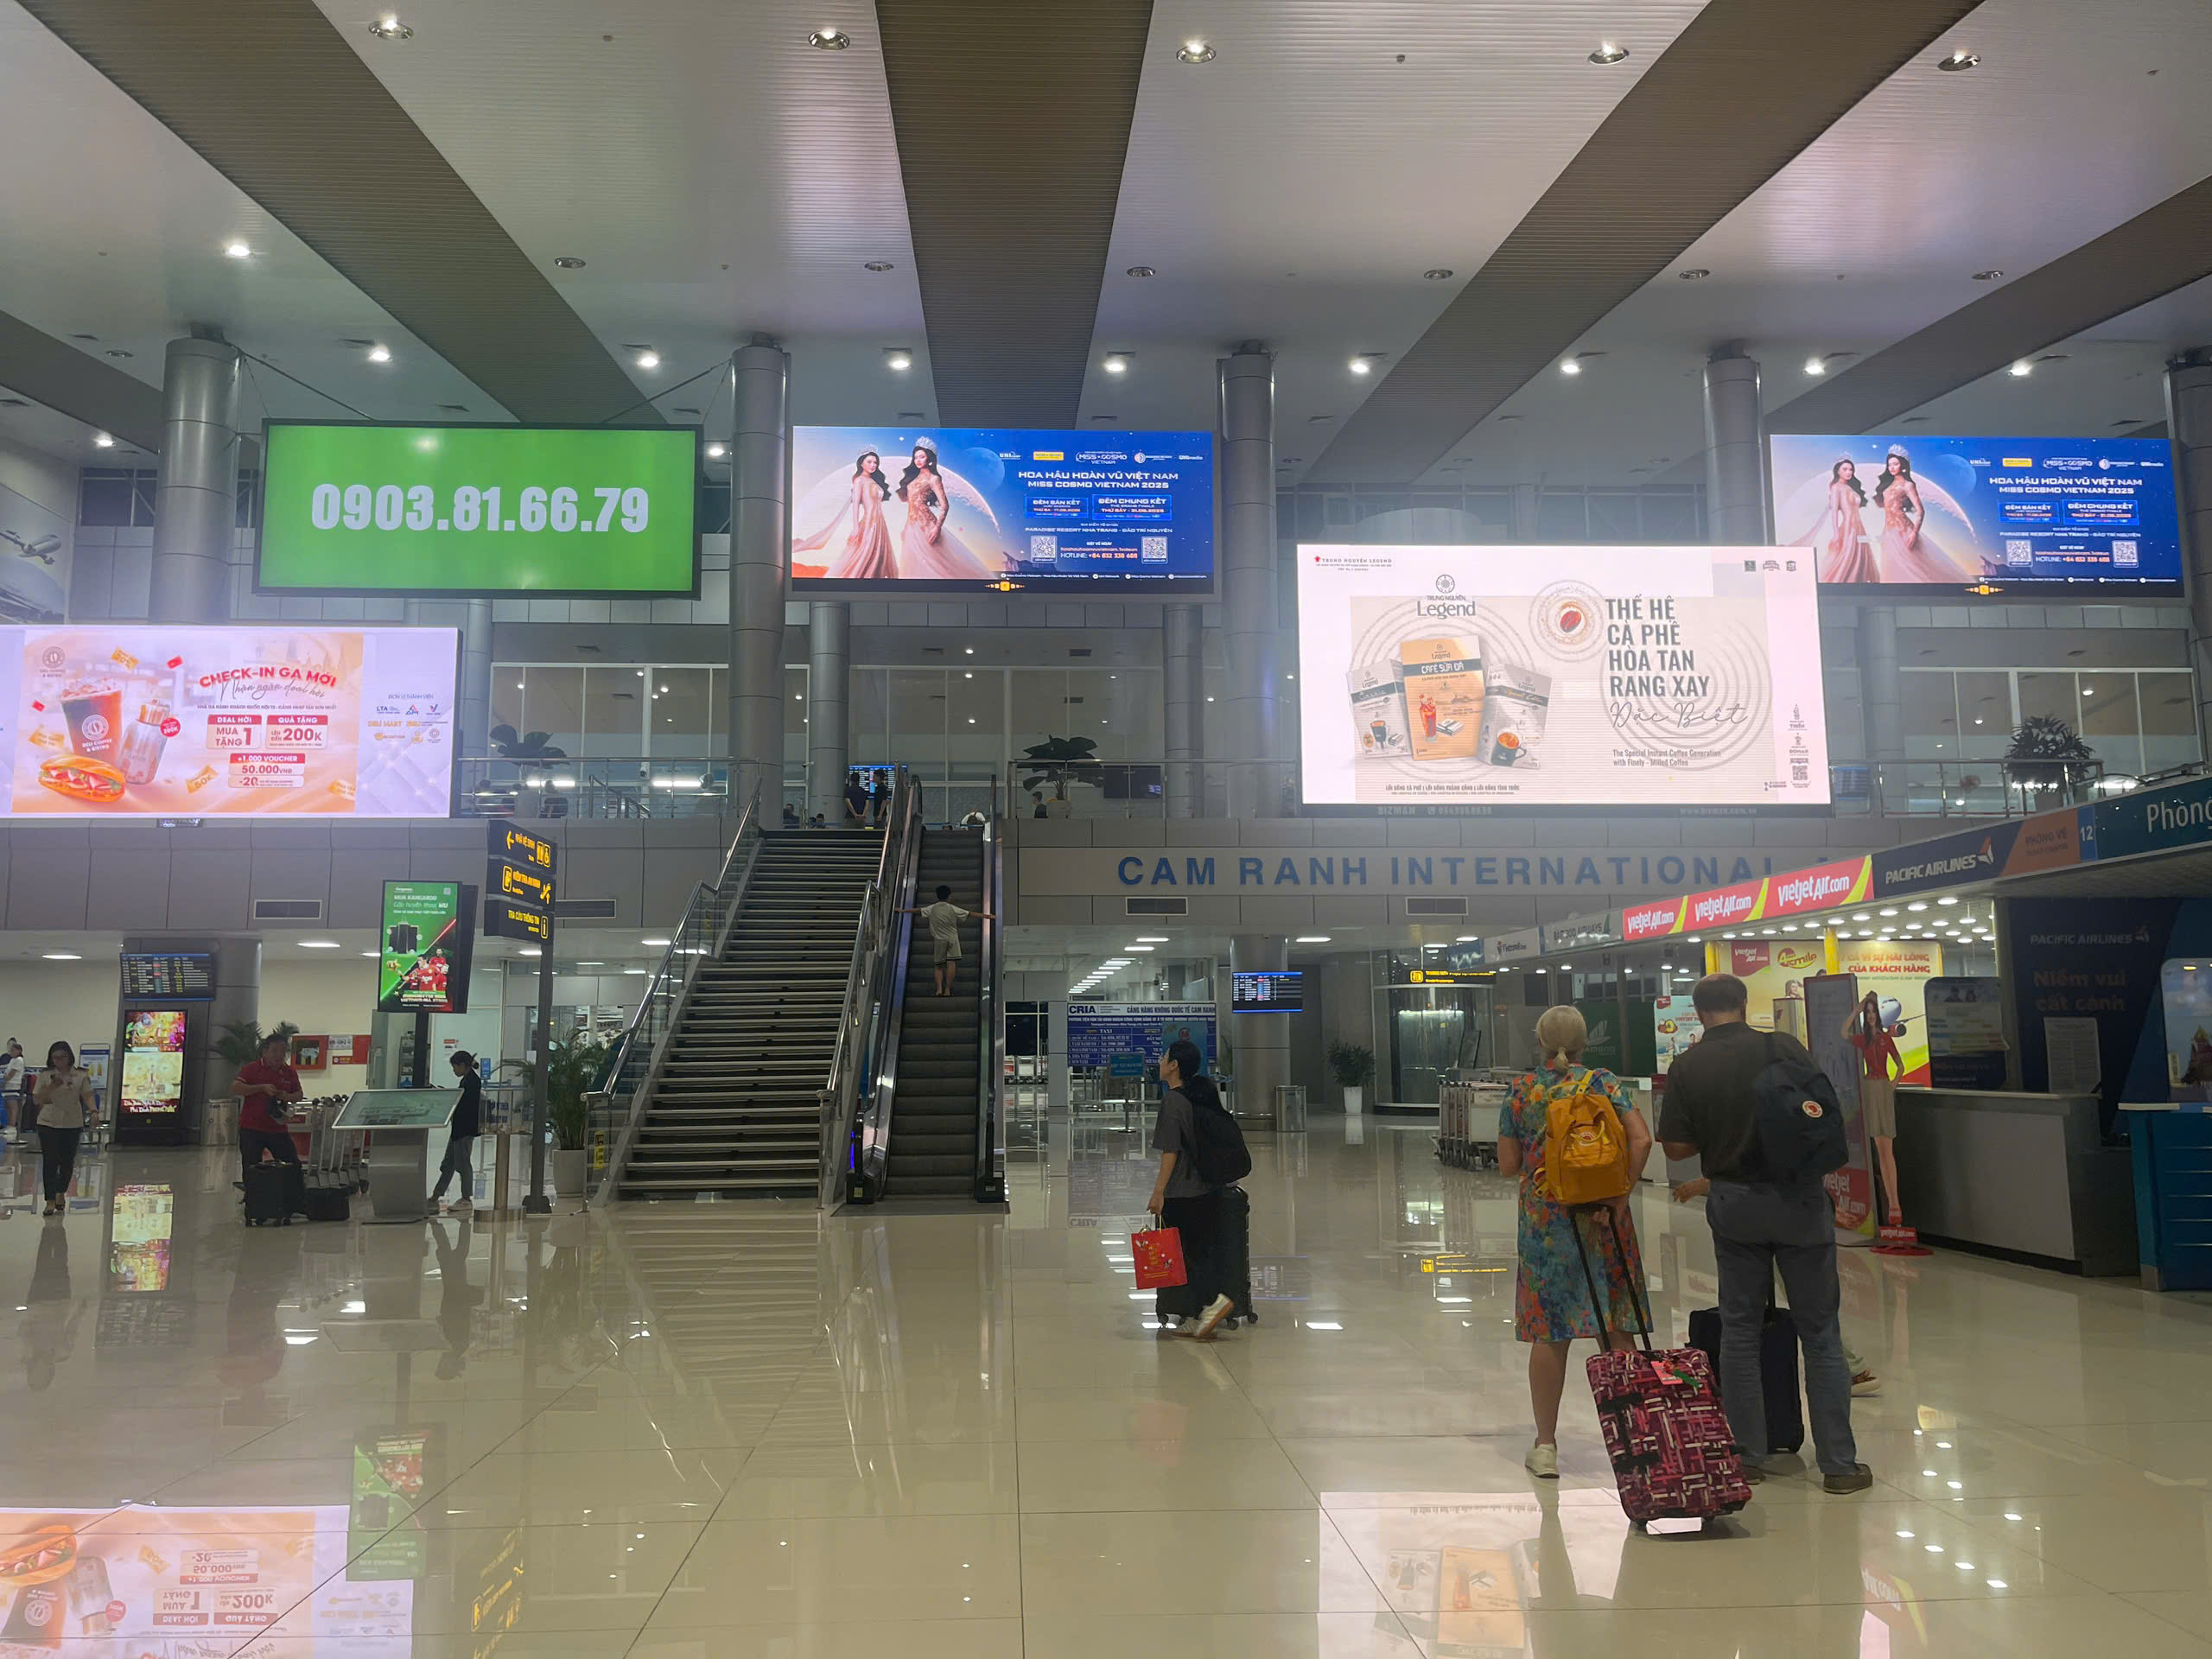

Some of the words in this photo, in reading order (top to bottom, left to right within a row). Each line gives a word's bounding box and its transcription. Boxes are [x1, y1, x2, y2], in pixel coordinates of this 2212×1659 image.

[1046, 470, 1070, 480] HẬU
[1072, 470, 1104, 480] HOÀN
[1107, 471, 1123, 480] VŨ
[1125, 471, 1150, 481] VIỆT
[2016, 477, 2039, 486] HẬU
[2041, 477, 2073, 486] HOÀN
[2093, 477, 2115, 486] VIỆT
[311, 484, 649, 532] 0903.81.66.79
[1417, 601, 1476, 620] Legend
[1605, 594, 1643, 620] THẾ
[1649, 595, 1675, 622] HỆ
[1607, 620, 1635, 646] CÀ
[1642, 620, 1681, 645] PHÊ
[1431, 652, 1451, 660] Legend
[1609, 645, 1651, 671] HÒA
[1657, 650, 1695, 671] TAN
[200, 667, 275, 688] CHECK-IN
[279, 667, 302, 679] GA
[306, 671, 337, 688] MỚI
[1611, 676, 1666, 696] RANG
[1673, 676, 1710, 696] XAY
[1611, 702, 1668, 728] Đặc
[1675, 702, 1747, 728] Biệt
[244, 728, 252, 746] 1
[283, 728, 322, 741] 200K
[216, 738, 243, 748] TẶNG
[1624, 749, 1645, 759] Special
[1628, 759, 1644, 767] Finely
[2025, 833, 2055, 845] PHÒNG
[2081, 825, 2094, 842] 12
[1118, 857, 1215, 886] CAM
[1239, 857, 1369, 886] RANH
[1885, 865, 1923, 884] PACIFIC
[1925, 855, 1977, 878] AIRLINES
[2031, 935, 2075, 945] PACIFIC
[2077, 934, 2133, 944] AIRLINES
[1885, 952, 1901, 963] HÀI
[1904, 952, 1929, 963] LÒNG
[1847, 963, 1866, 973] CỦA
[1869, 963, 1901, 973] KHÁCH
[1903, 963, 1930, 973] HÀNG
[2097, 971, 2127, 987] vui
[1070, 1006, 1096, 1014] CRIA
[1172, 1006, 1184, 1014] QUỐC
[1823, 1173, 1850, 1196] ietjet
